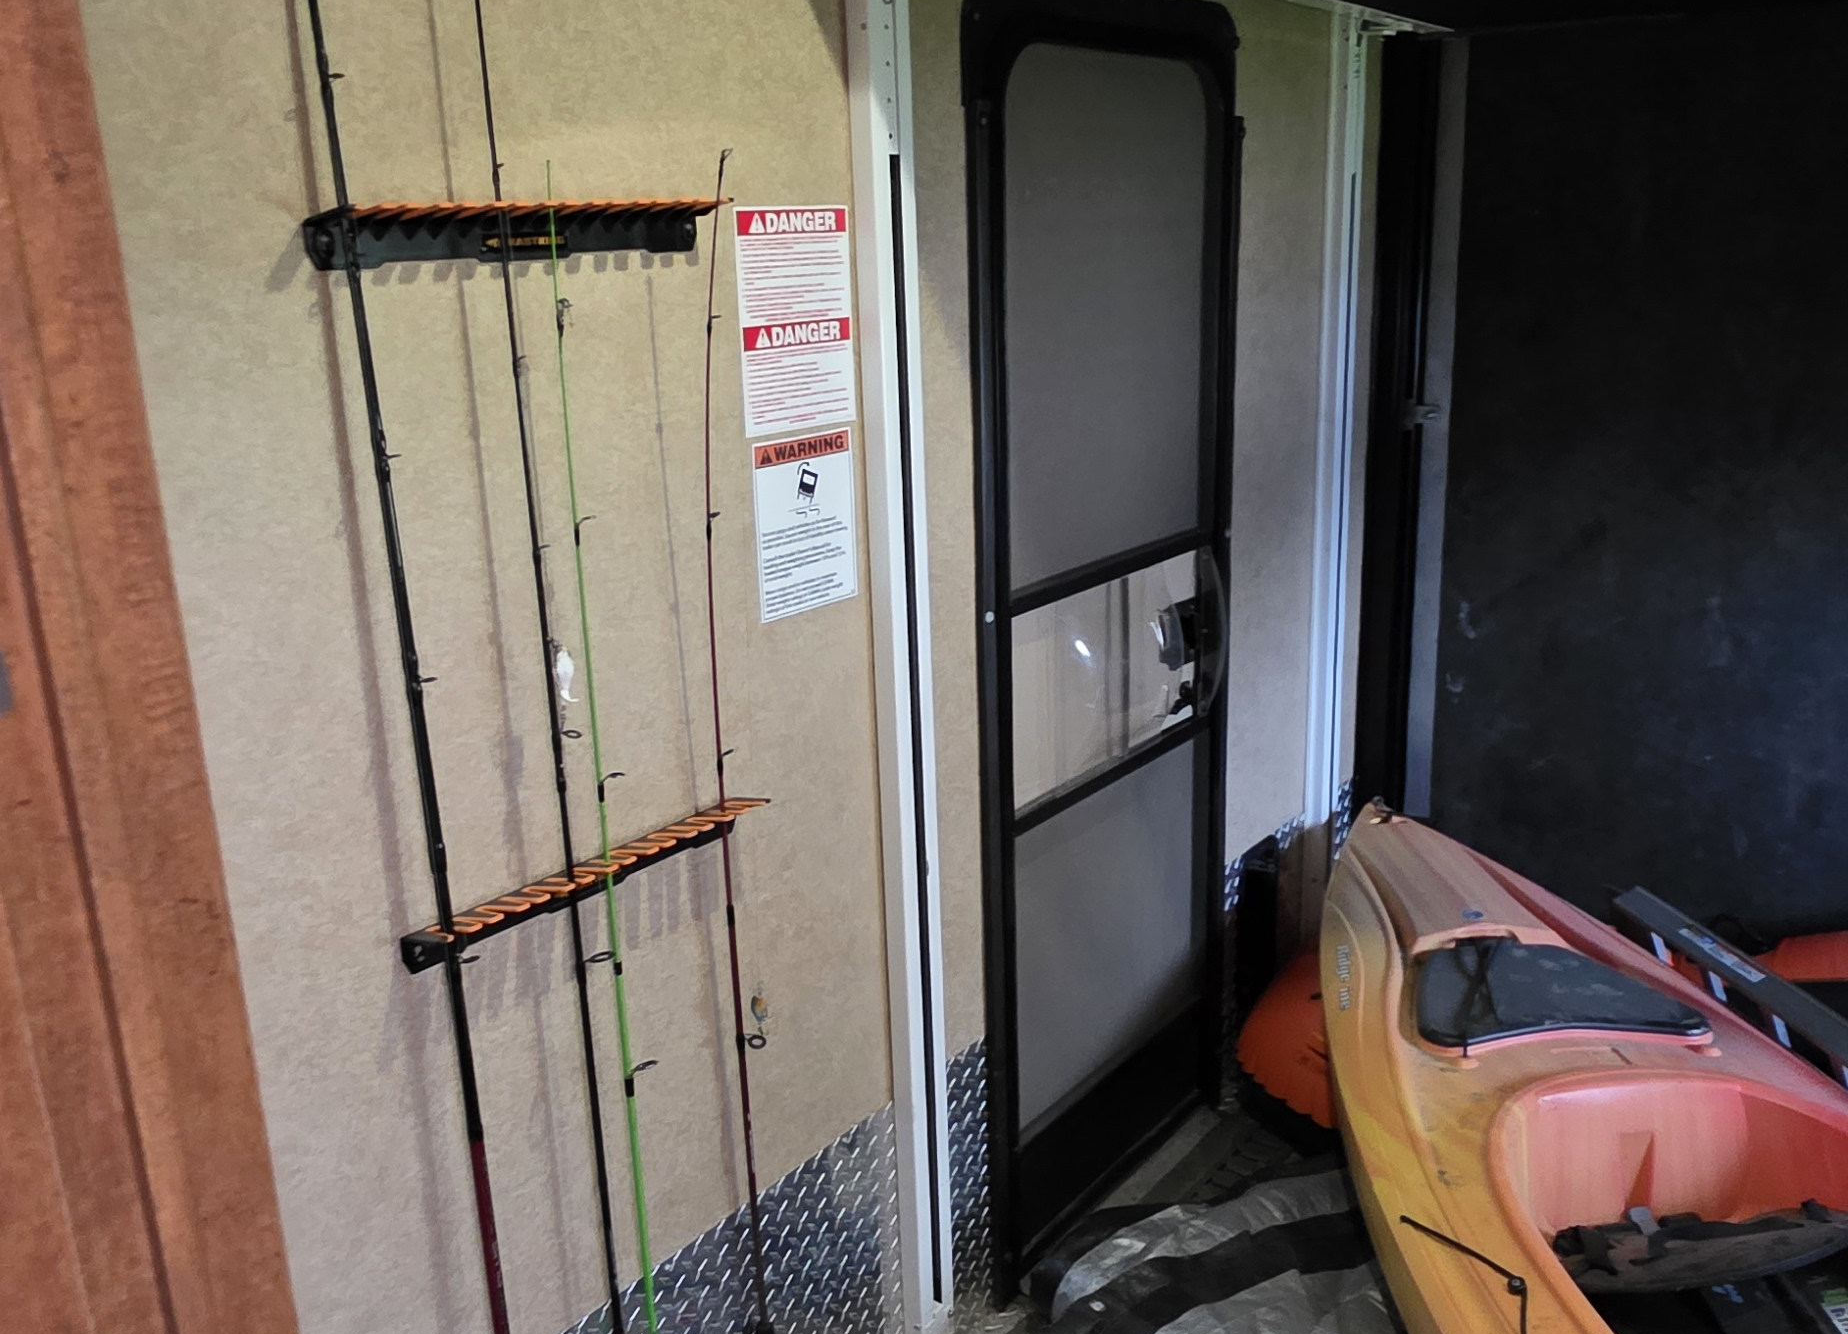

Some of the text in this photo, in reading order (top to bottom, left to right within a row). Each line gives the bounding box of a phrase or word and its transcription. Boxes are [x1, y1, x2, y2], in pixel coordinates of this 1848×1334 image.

[764, 211, 837, 234] DANGER
[771, 321, 841, 347] DANGER
[774, 435, 845, 462] WARNING
